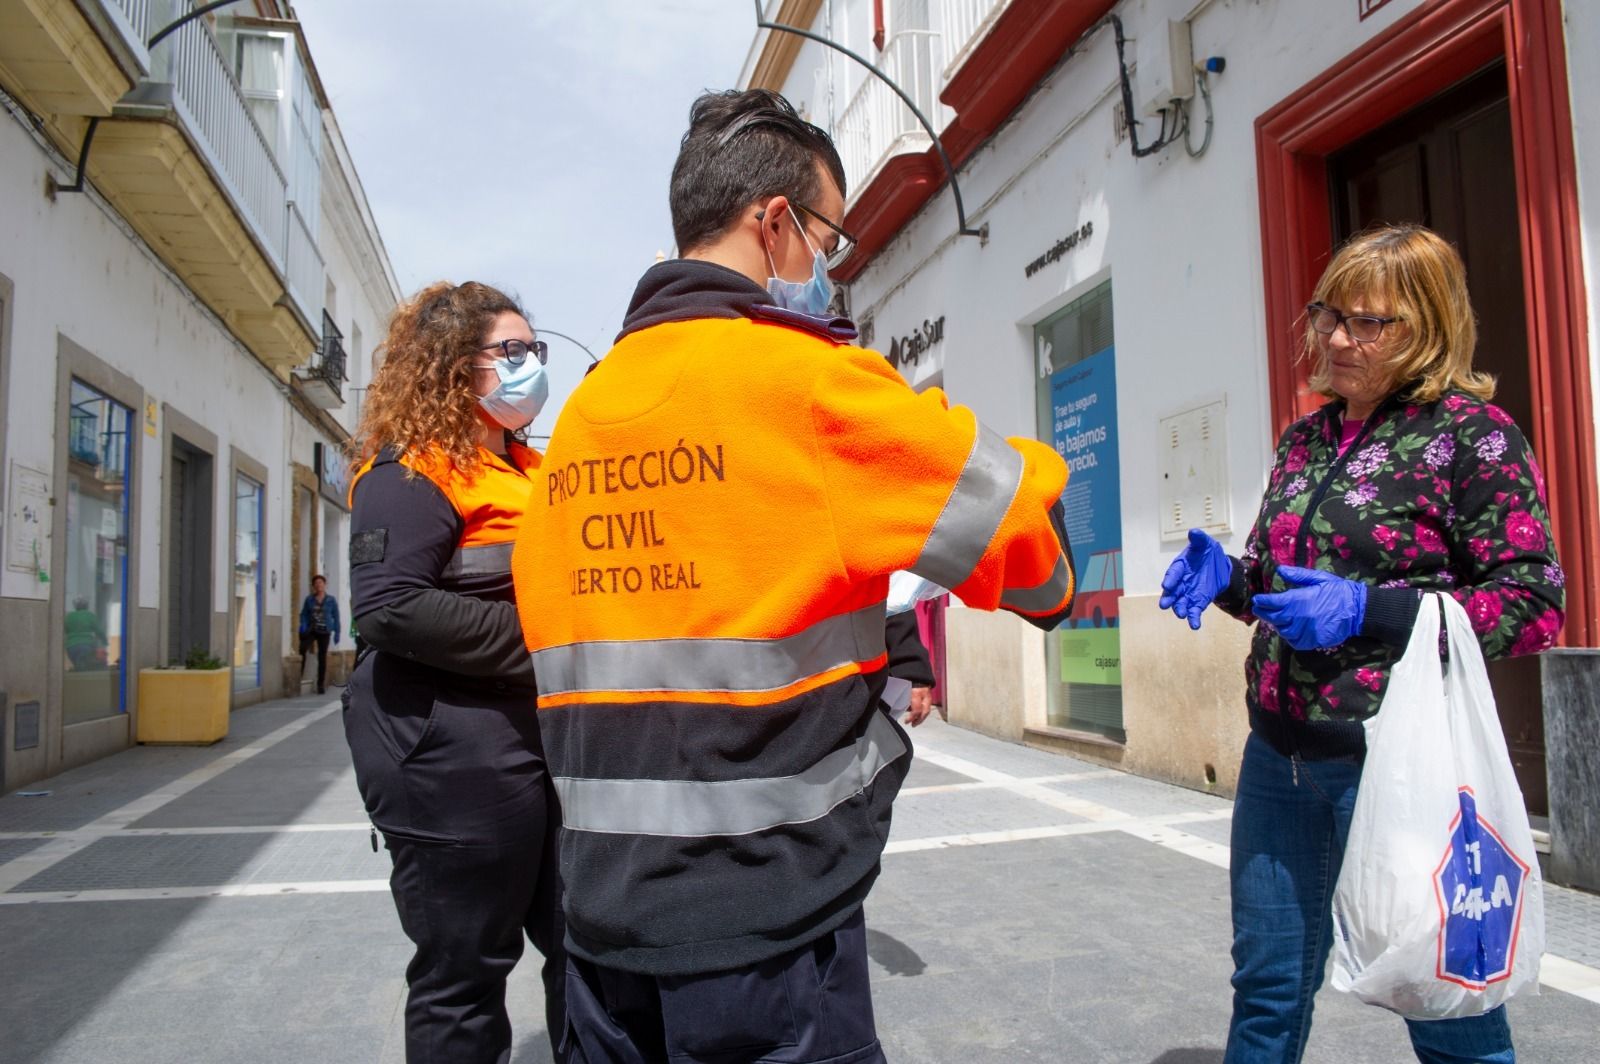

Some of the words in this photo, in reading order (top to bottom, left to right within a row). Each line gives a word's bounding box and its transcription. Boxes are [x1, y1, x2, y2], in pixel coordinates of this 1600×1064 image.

[1025, 221, 1093, 278] www.cajasur.es
[900, 315, 945, 366] CajaSur
[1054, 405, 1067, 418] Trae
[1068, 401, 1074, 413] tu
[1075, 393, 1097, 411] seguro
[1055, 420, 1062, 433] de
[1063, 416, 1076, 430] auto
[1056, 439, 1064, 455] te
[1066, 426, 1106, 454] bajamos
[548, 439, 725, 505] PROTECCIÓN
[581, 510, 665, 551] CIVIL
[651, 561, 701, 592] REAL
[1095, 655, 1121, 670] cajasur
